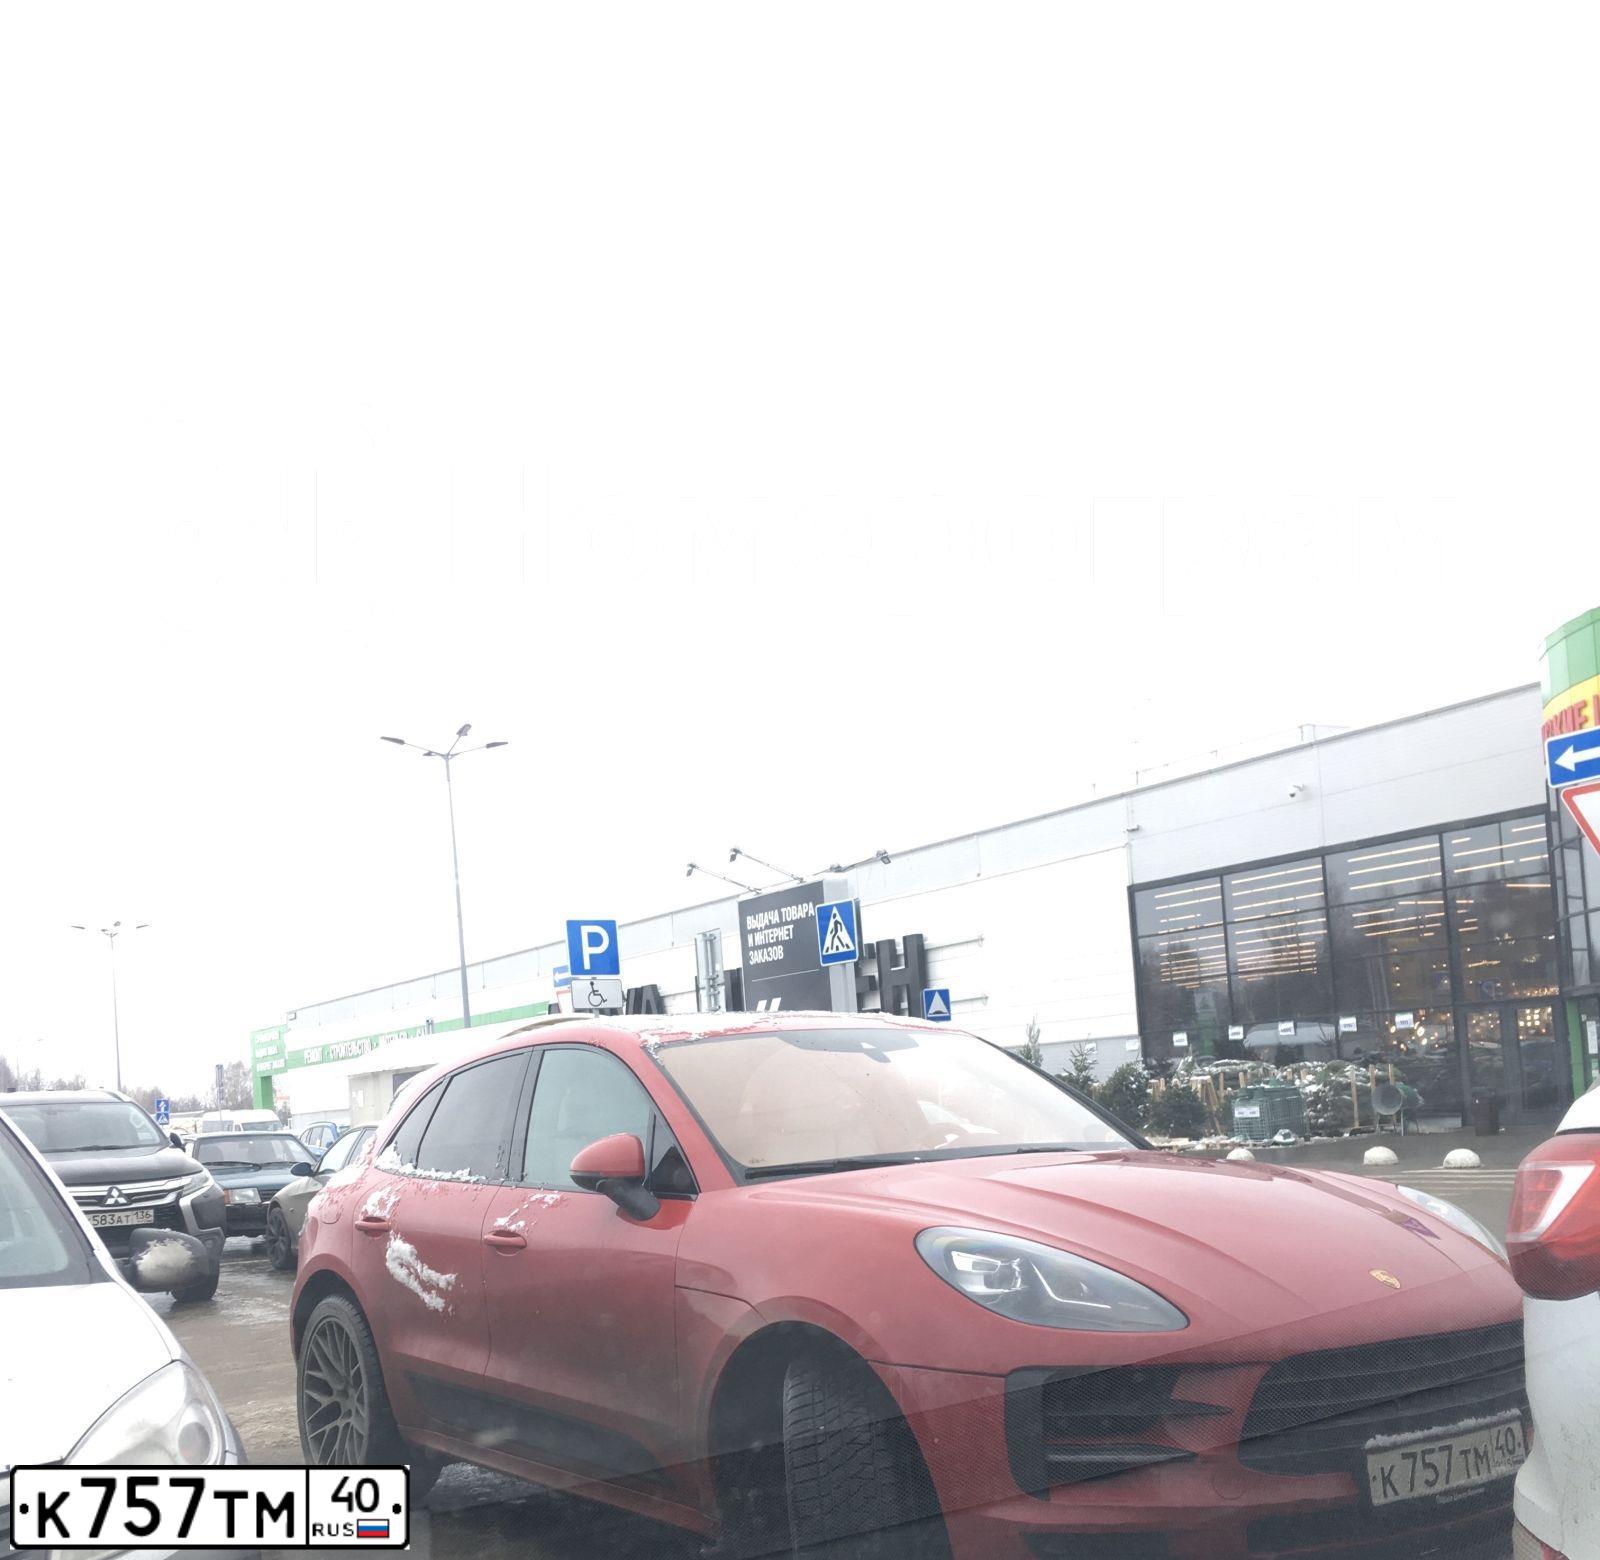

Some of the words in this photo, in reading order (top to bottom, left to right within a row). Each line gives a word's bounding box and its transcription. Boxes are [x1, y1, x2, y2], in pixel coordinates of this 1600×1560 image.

[746, 909, 780, 931] ВЫДАЧА
[780, 902, 815, 923] ТОВАРА
[580, 925, 610, 970] P
[747, 932, 754, 948] И
[754, 924, 794, 946] ИНТЕРНЕТ
[749, 945, 784, 965] ЗАКАЗОВ
[88, 1214, 131, 1226] 583АТ
[133, 1210, 152, 1220] 136
[1380, 1444, 1491, 1498] К757ТМ
[1495, 1427, 1516, 1456] 40
